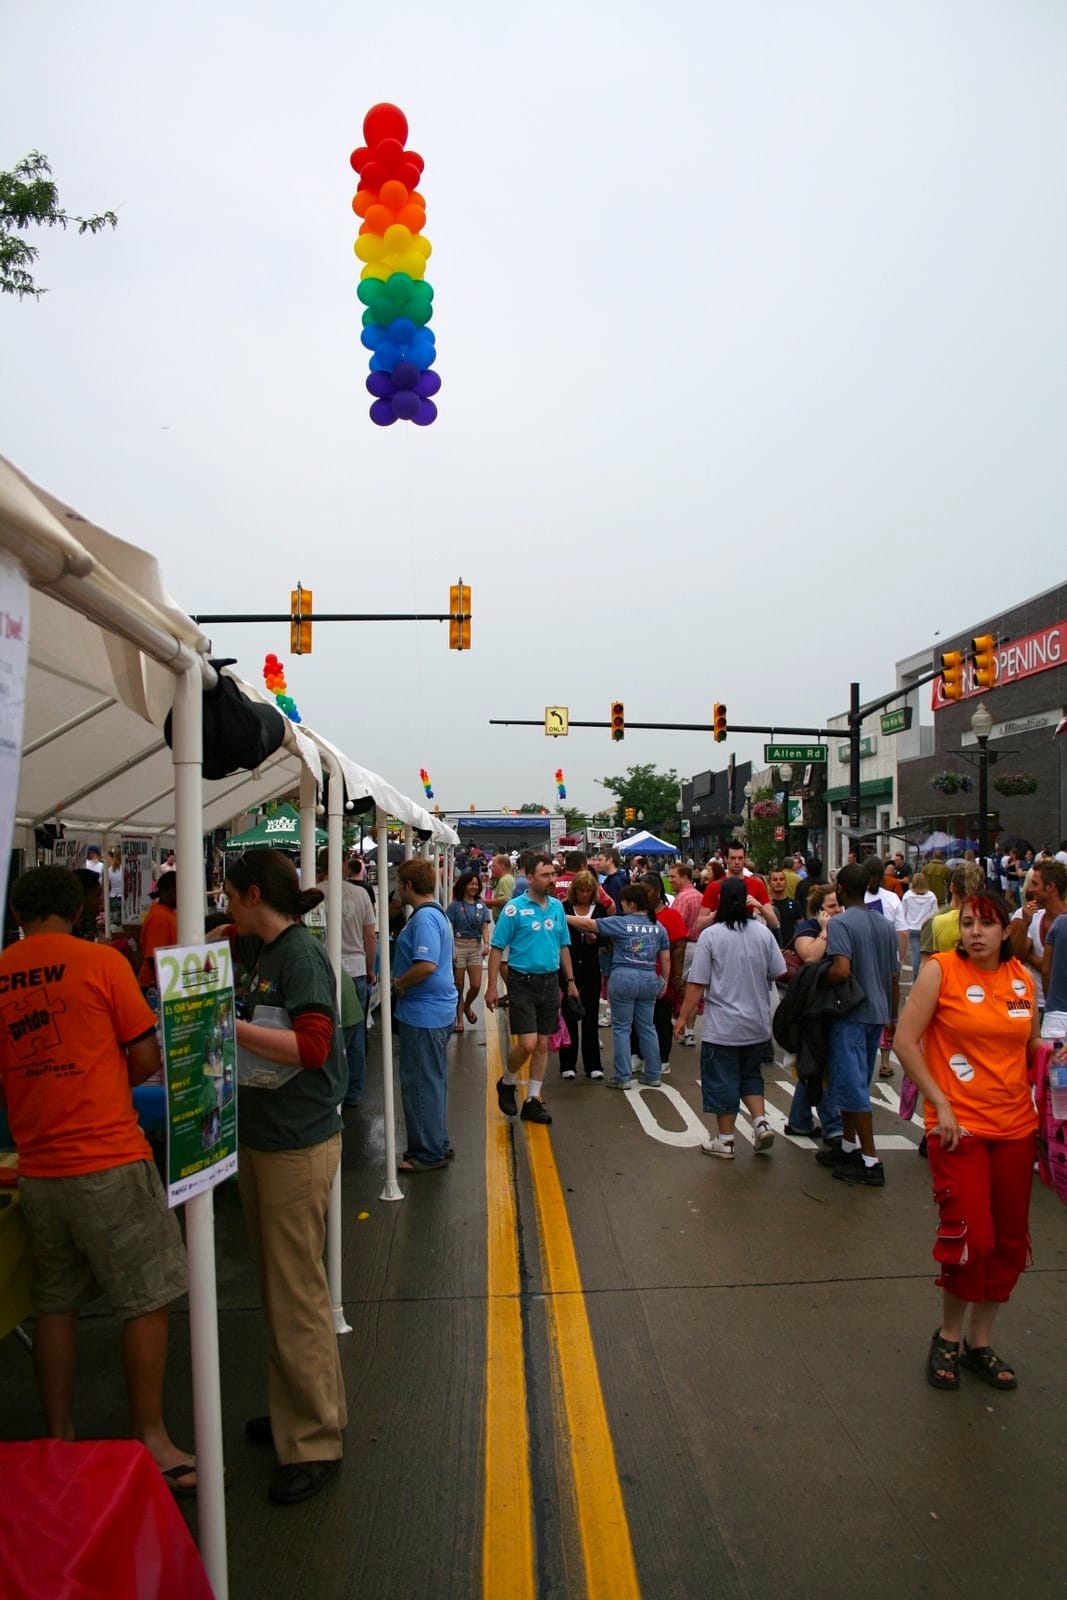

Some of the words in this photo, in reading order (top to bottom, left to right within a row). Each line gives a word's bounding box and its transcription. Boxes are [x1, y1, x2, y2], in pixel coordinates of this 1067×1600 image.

[773, 749, 802, 758] Allen
[807, 749, 820, 758] Rd
[267, 816, 297, 826] WHOLE
[55, 842, 67, 858] GET
[555, 880, 573, 888] DIREC
[626, 925, 659, 934] STAFF
[0, 964, 65, 993] CREW
[160, 948, 229, 1000] 2007
[8, 1009, 50, 1041] pride
[180, 1160, 203, 1177] AUGUST
